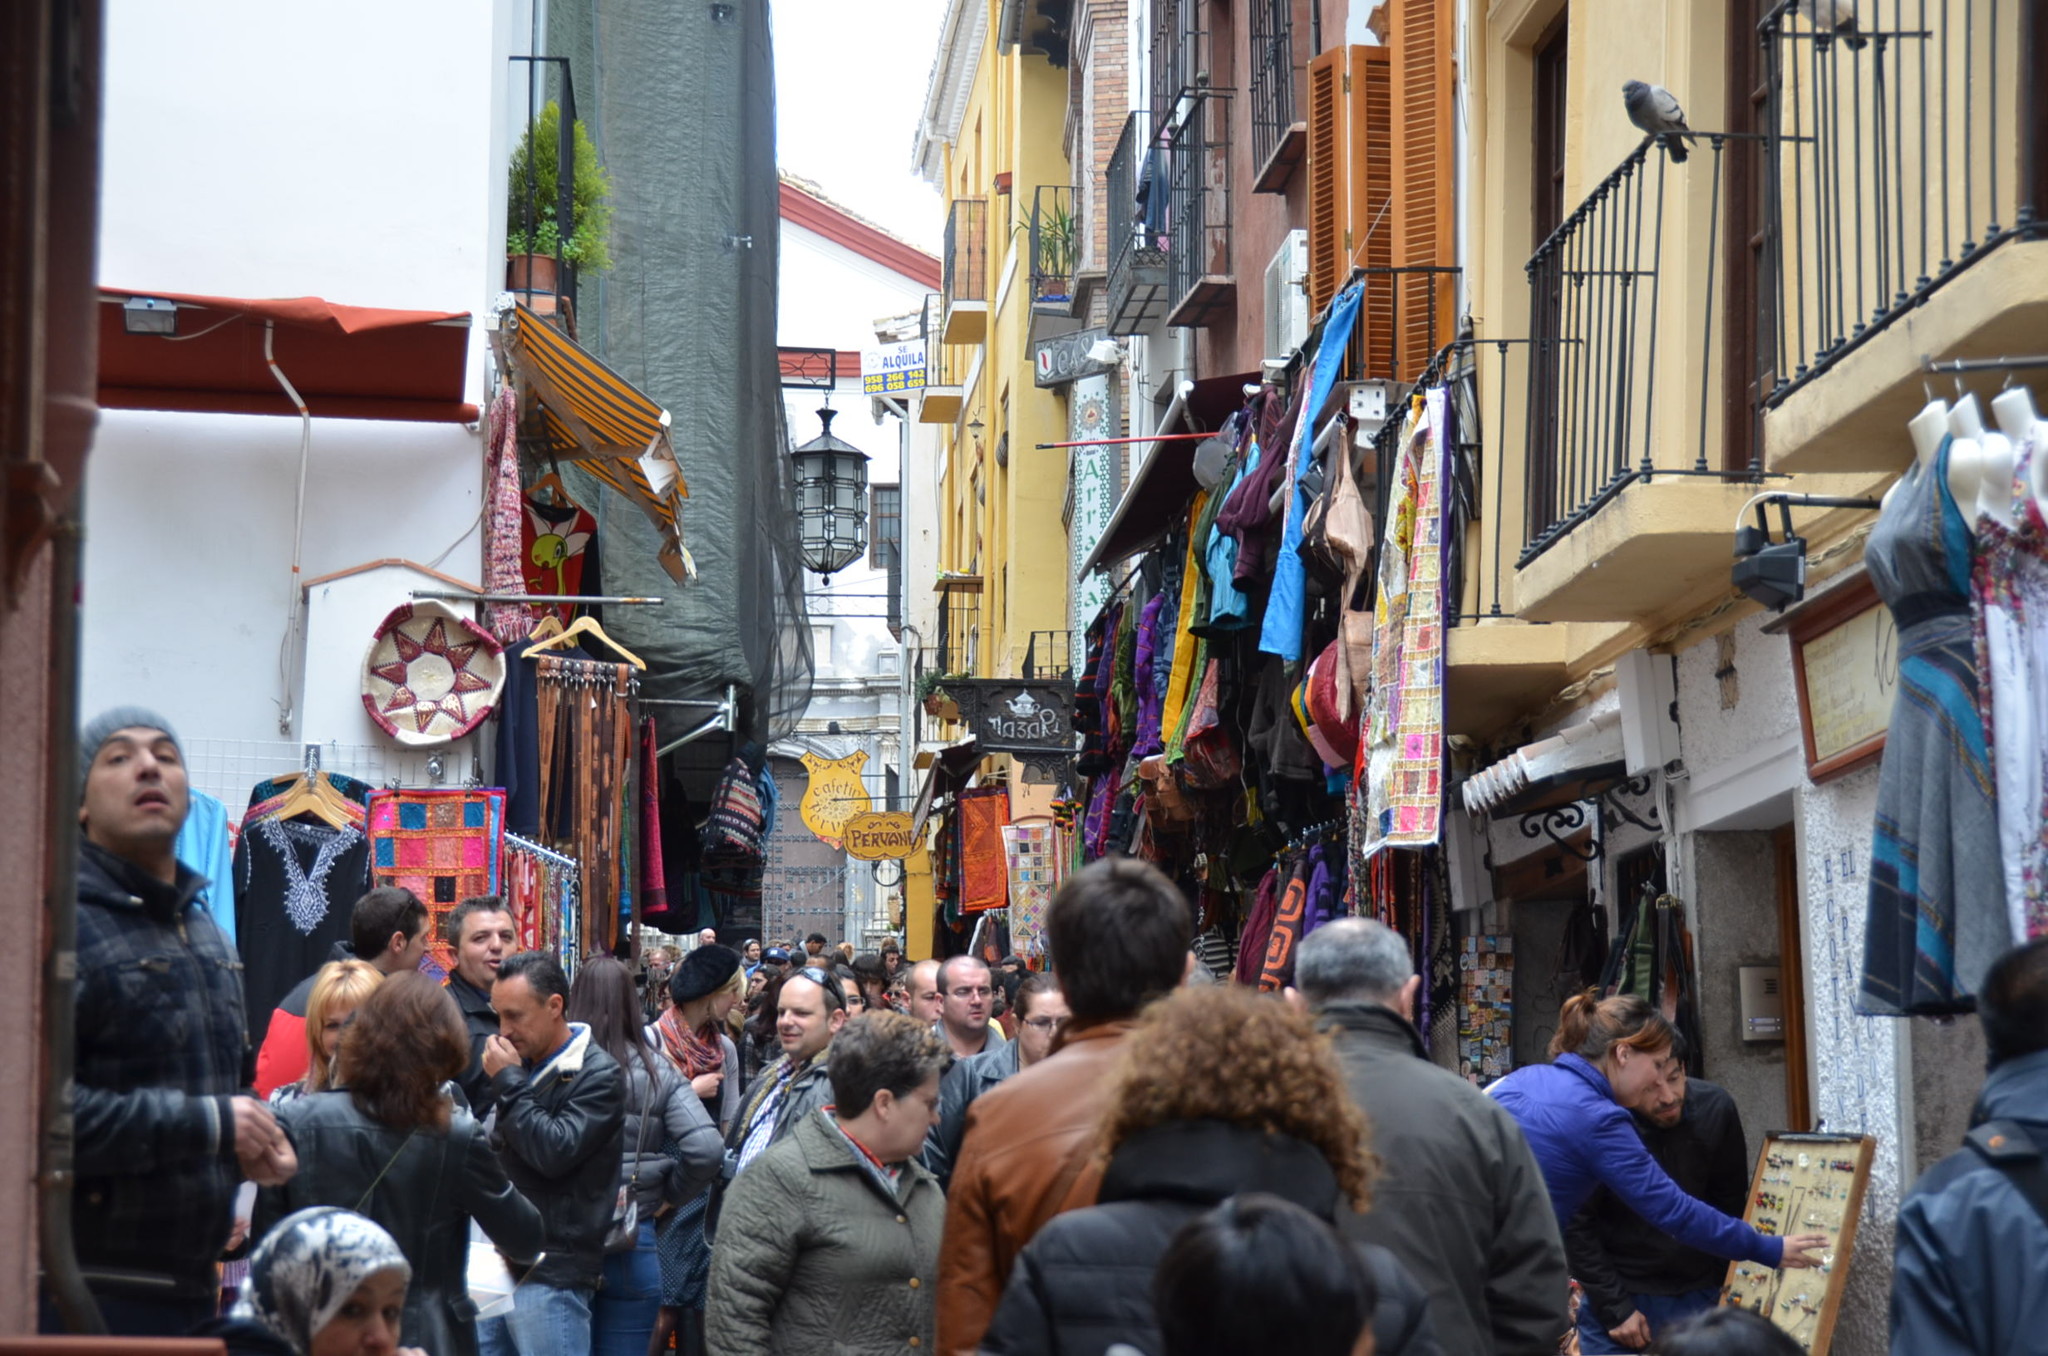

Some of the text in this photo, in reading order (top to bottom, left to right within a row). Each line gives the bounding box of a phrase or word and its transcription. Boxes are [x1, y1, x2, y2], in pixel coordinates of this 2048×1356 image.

[898, 345, 908, 354] SE
[882, 351, 924, 369] ALQUILA
[864, 374, 883, 384] 958
[887, 371, 905, 382] 266
[864, 378, 925, 393] 696 058 659
[1841, 850, 1856, 877] EL
